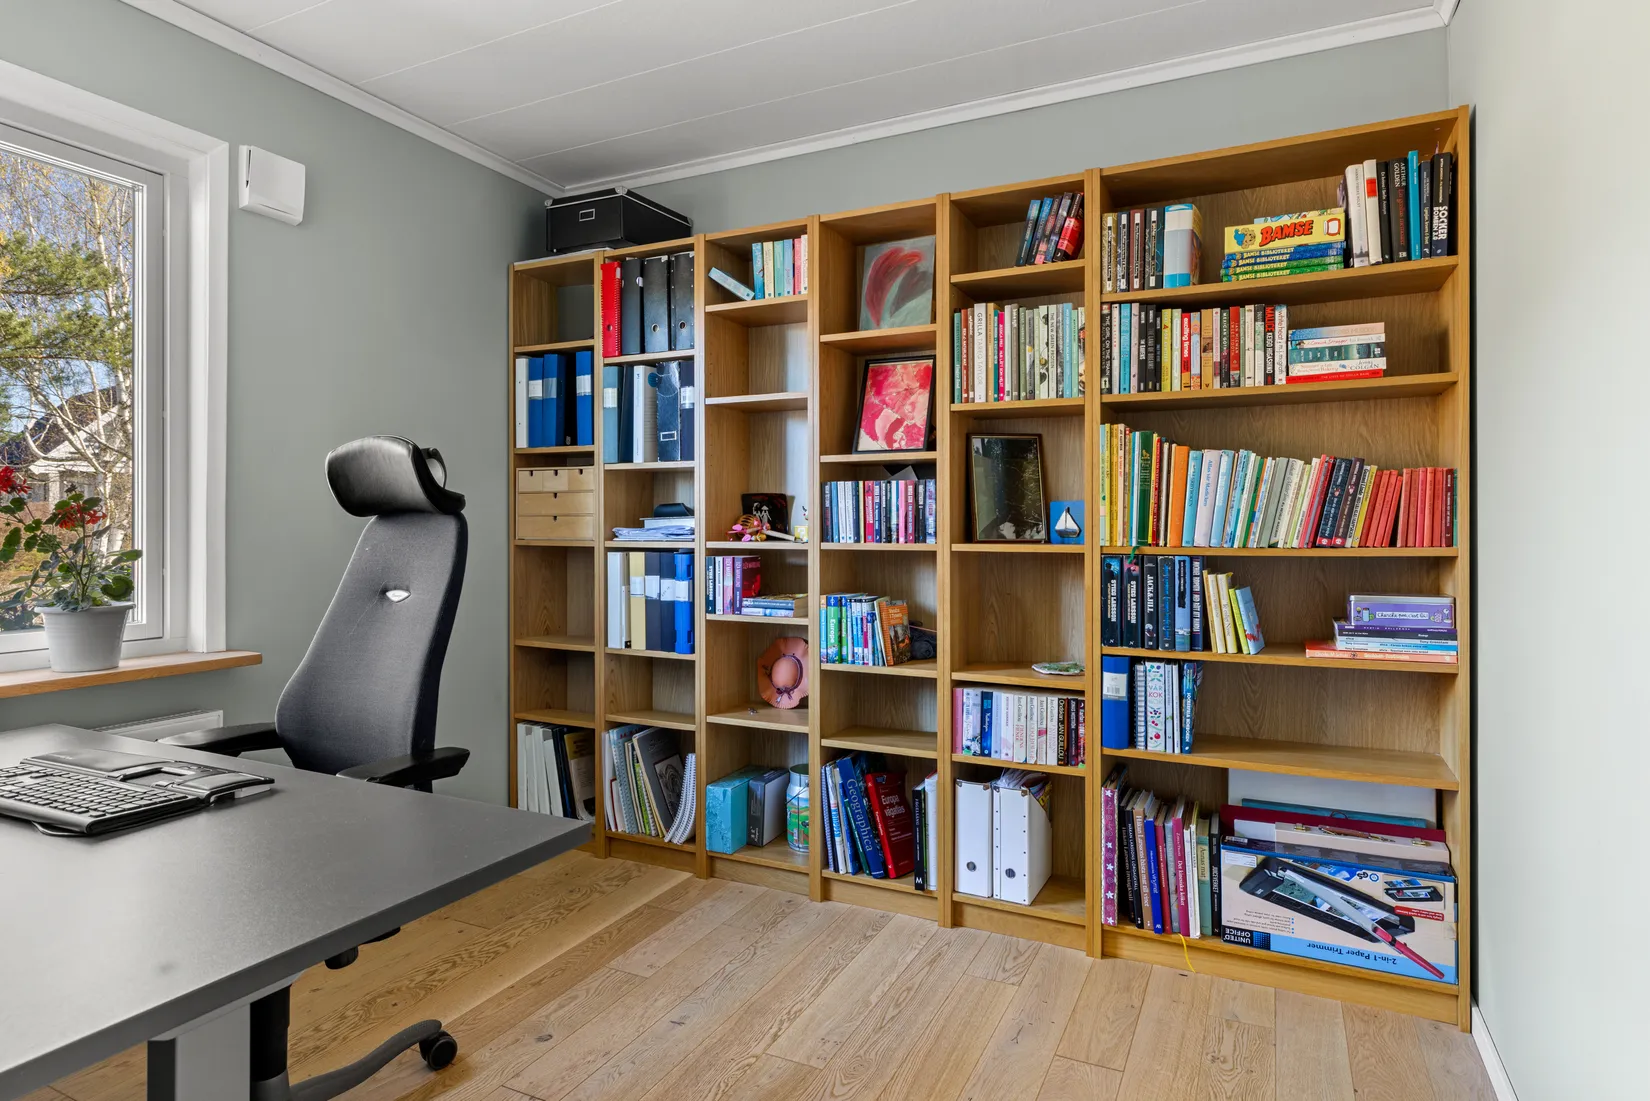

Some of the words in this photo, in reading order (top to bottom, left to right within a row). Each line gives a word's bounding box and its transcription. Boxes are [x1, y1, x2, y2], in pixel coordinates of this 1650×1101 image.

[1438, 206, 1448, 240] SOCKER
[1259, 220, 1314, 247] BAMSE
[1261, 248, 1294, 256] BIBLIOTEKET
[1254, 262, 1287, 270] BIBLIOTEKET
[1256, 270, 1290, 278] BIBLIOTEKET
[1266, 307, 1274, 332] MALICE
[1361, 468, 1369, 484] Gunnel
[1358, 484, 1366, 495] Linde
[881, 795, 900, 805] Europa
[846, 779, 874, 851] Geographica
[884, 805, 905, 818] vägatlas
[1225, 928, 1251, 938] OFFICE
[1224, 934, 1251, 944] UNITED
[1307, 943, 1343, 955] Trimmer
[1346, 949, 1370, 961] Paper
[1373, 954, 1397, 964] 2-in-1
